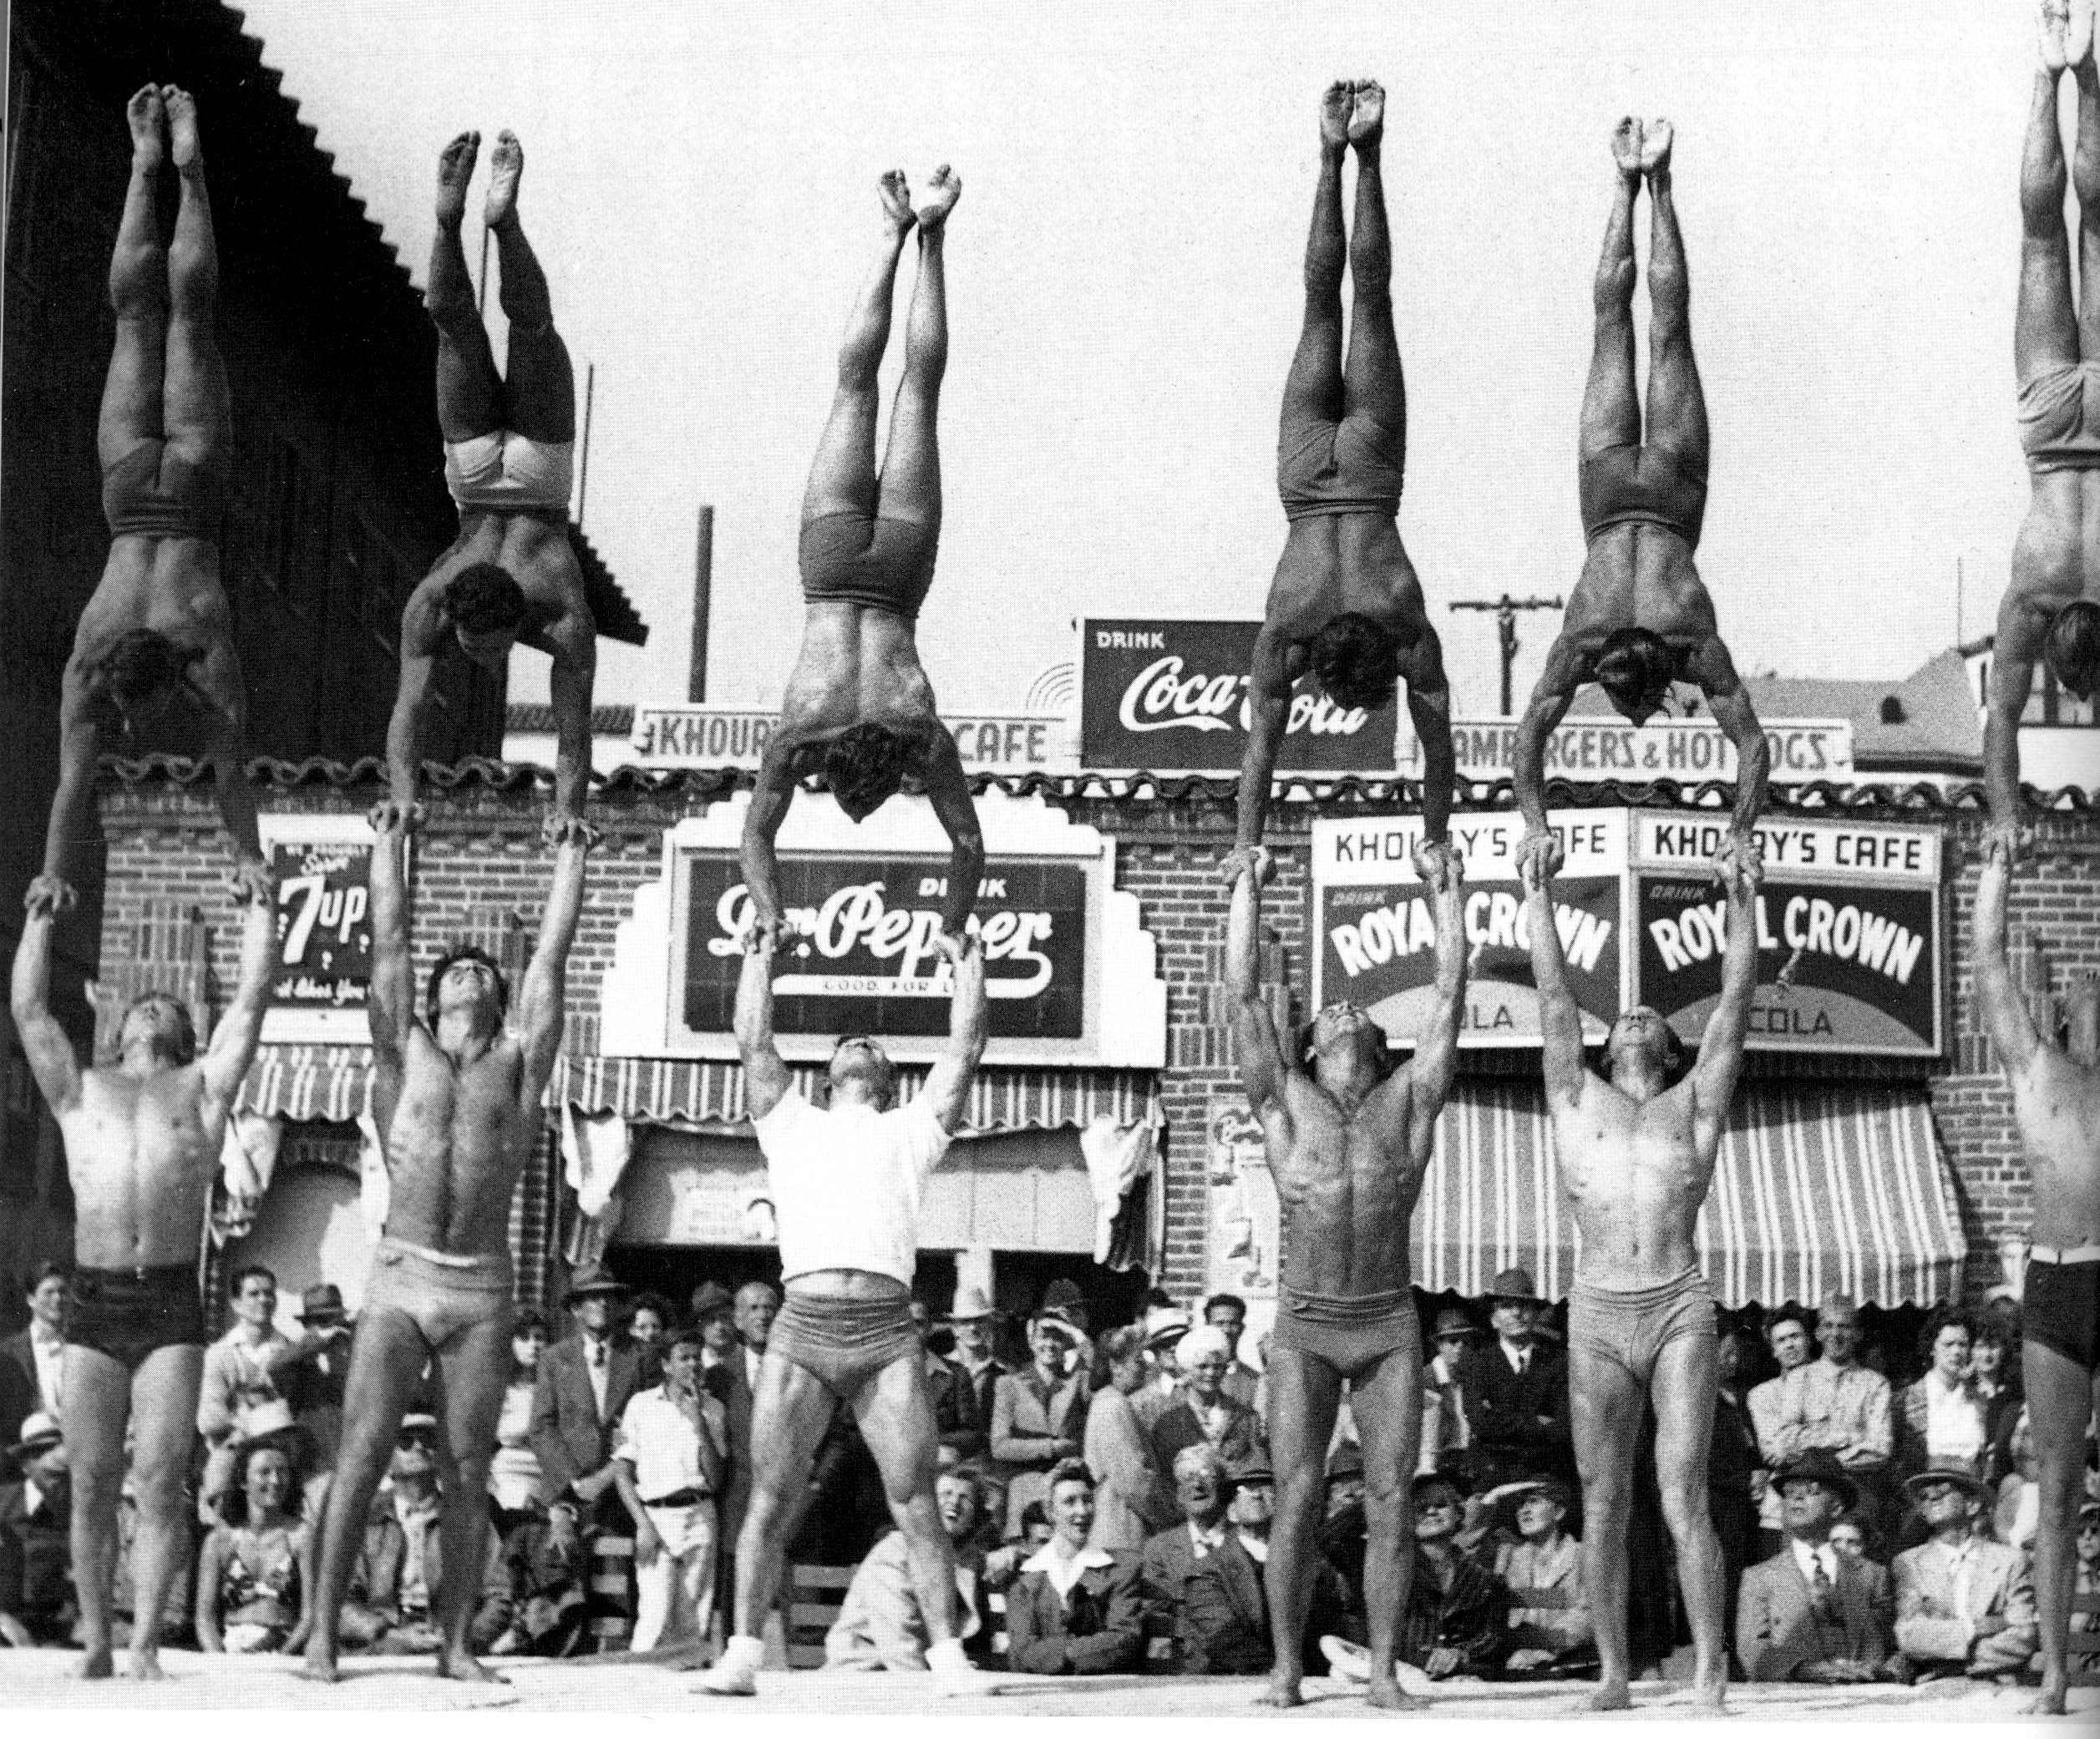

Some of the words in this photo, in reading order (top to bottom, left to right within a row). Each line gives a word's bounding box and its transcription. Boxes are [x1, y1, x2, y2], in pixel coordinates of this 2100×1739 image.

[1097, 631, 1165, 649] DRINK
[660, 717, 779, 758] KHOUR
[953, 722, 1047, 763] CAFE
[1642, 741, 1661, 768] &
[1668, 732, 1726, 770] HOT
[1767, 733, 1827, 770] OGS
[1337, 828, 1507, 862] KHOY'S
[1656, 824, 1816, 863] KHORY'S
[1835, 834, 1921, 870] CAFE
[1331, 898, 1435, 977] ROYA
[1649, 895, 1778, 972] ROYL
[1783, 895, 1923, 985] CROWN
[1750, 1006, 1833, 1036] COLA
